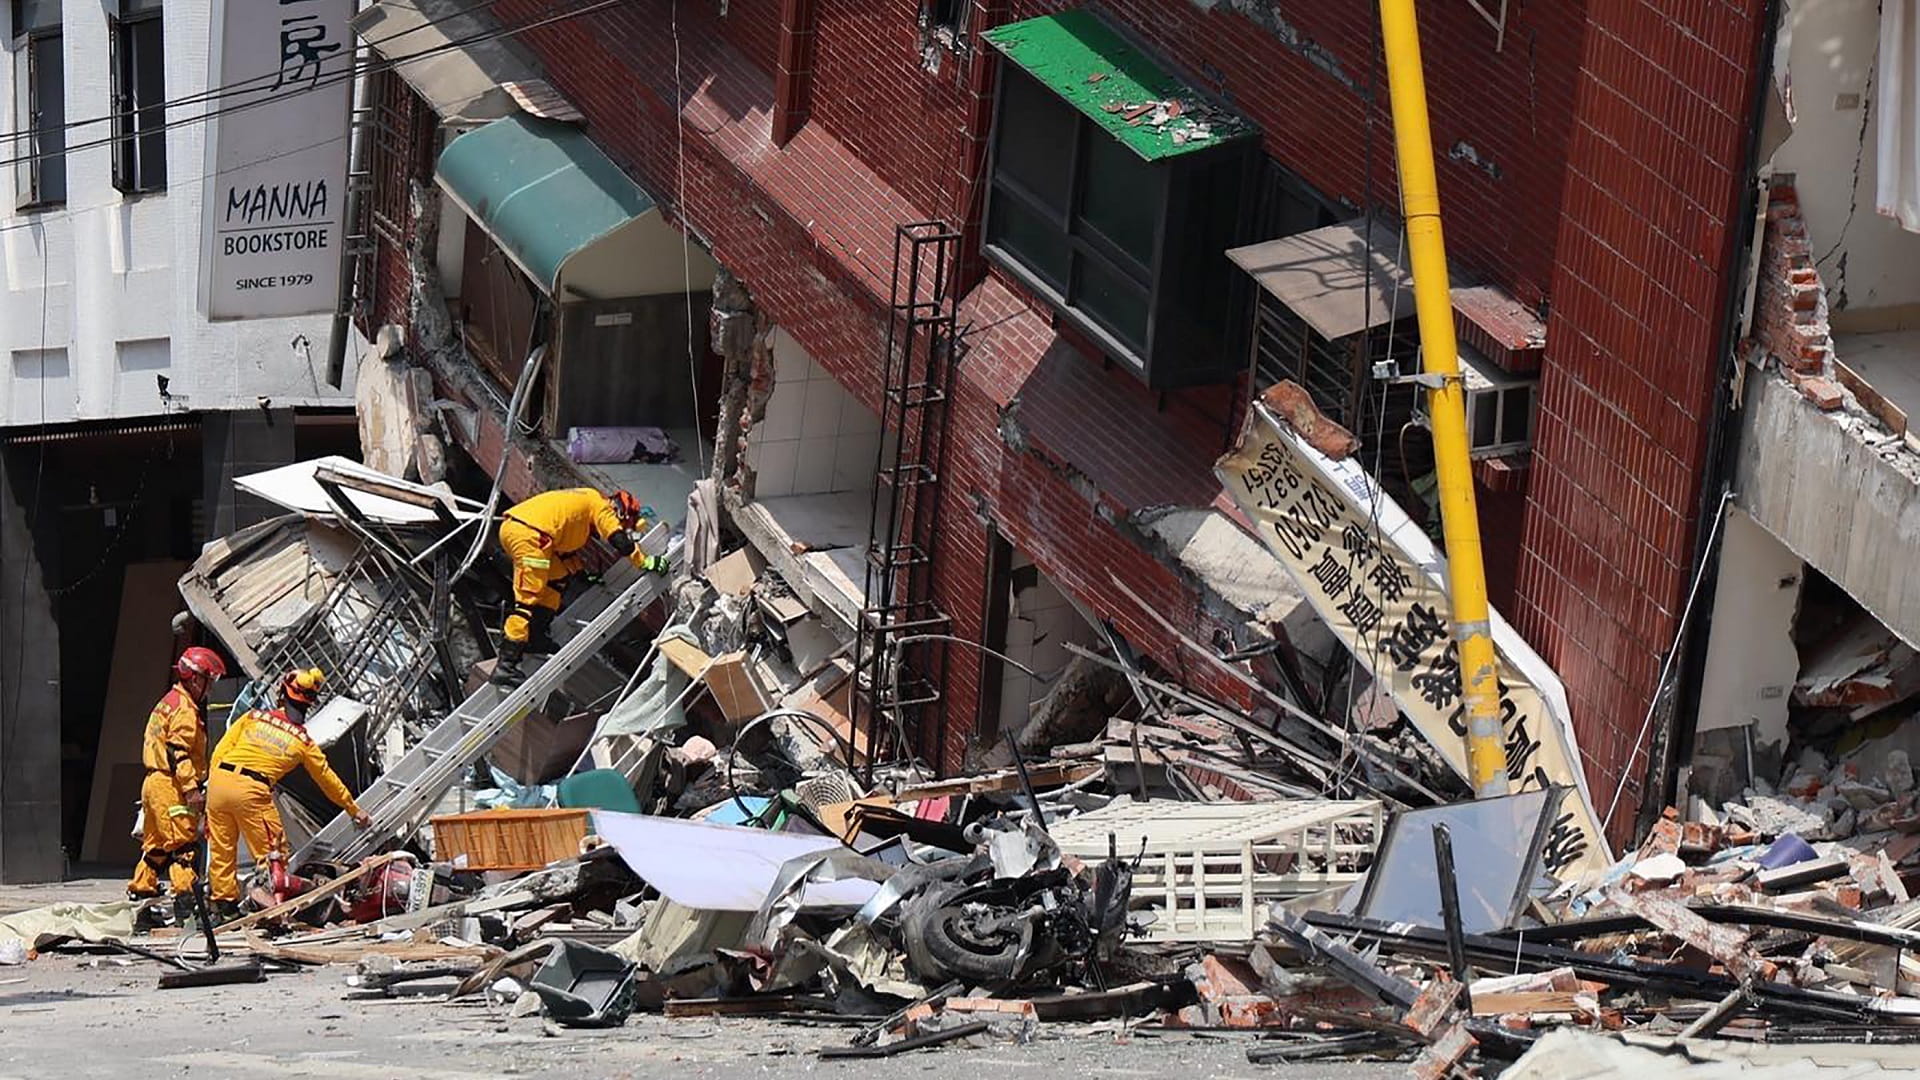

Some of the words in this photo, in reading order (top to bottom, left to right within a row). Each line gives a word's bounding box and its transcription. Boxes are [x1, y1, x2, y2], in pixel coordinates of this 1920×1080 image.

[226, 178, 328, 224] MANNA
[224, 229, 328, 256] BOOKSTORE
[236, 277, 276, 290] SINCE
[279, 274, 313, 287] 1979
[1342, 524, 1413, 604] 維修
[1306, 547, 1384, 634] 買賣
